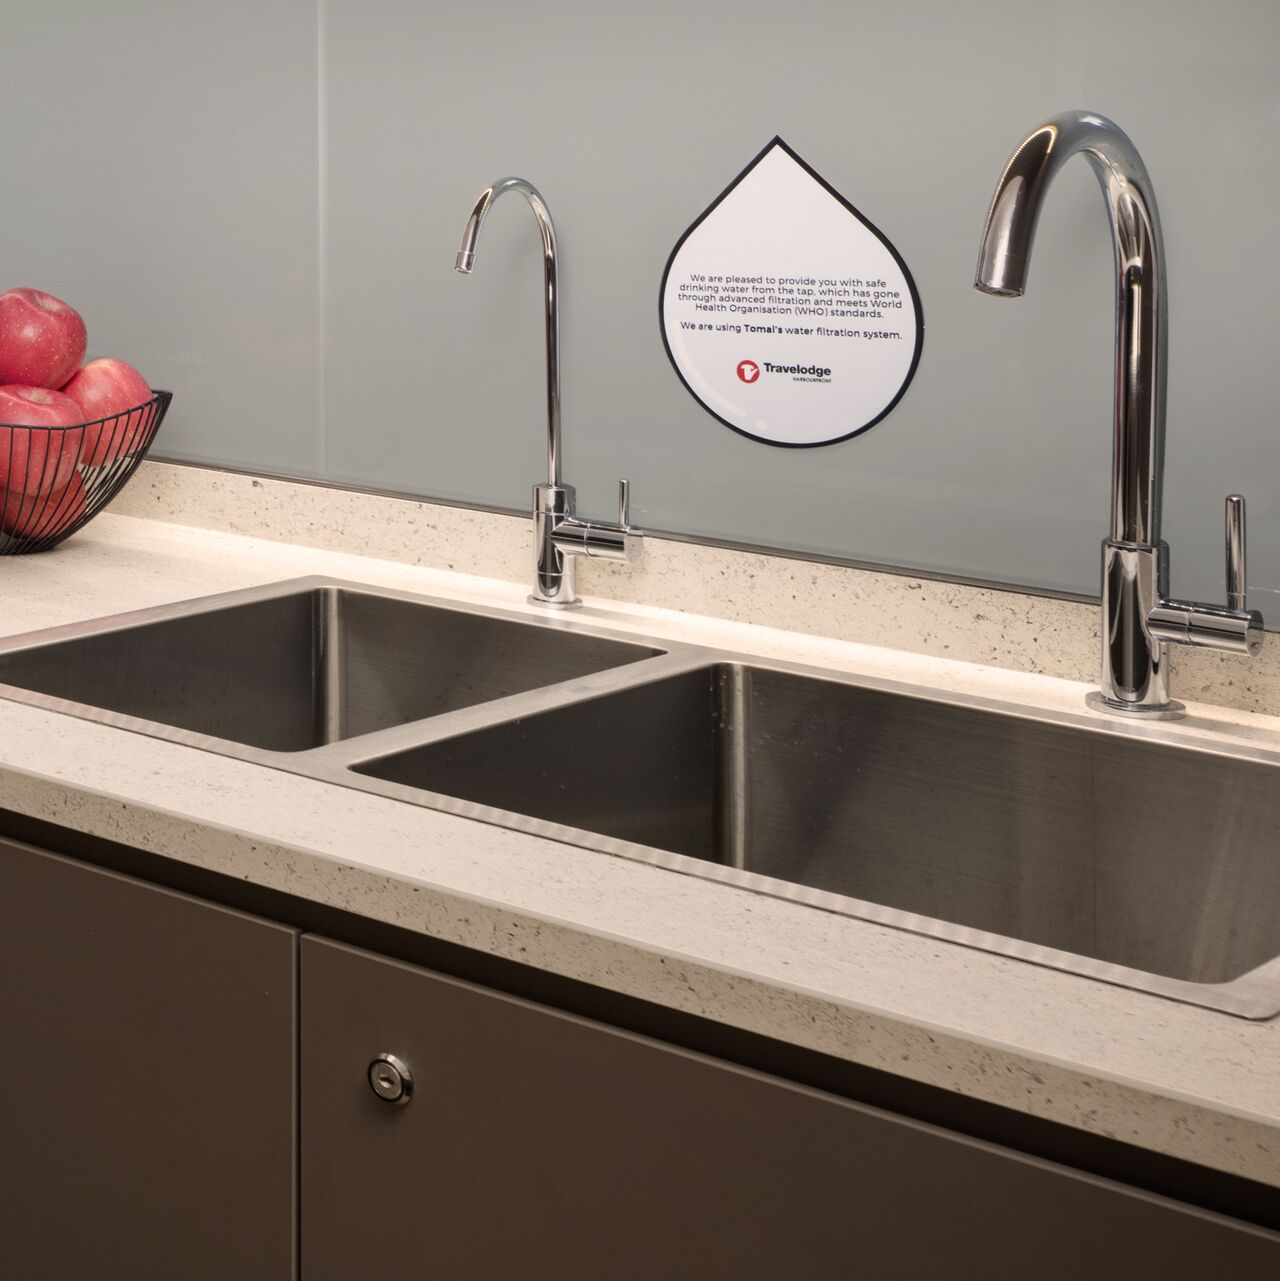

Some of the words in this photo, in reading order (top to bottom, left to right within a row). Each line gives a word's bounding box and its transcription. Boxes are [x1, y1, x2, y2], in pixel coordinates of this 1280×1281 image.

[690, 274, 706, 283] We
[708, 275, 723, 283] are
[725, 275, 763, 285] pleased
[765, 277, 776, 285] to
[778, 277, 816, 287] provide
[818, 280, 837, 288] you
[840, 279, 863, 288] with
[865, 279, 887, 289] safe
[679, 283, 719, 294] drinking
[721, 286, 749, 294] water
[751, 285, 775, 294] from
[777, 287, 794, 295] the
[818, 288, 850, 297] which
[852, 289, 871, 298] has
[873, 291, 900, 300] gone
[678, 293, 716, 303] through
[718, 294, 765, 304] advanced
[768, 296, 811, 306] filtration
[813, 298, 833, 307] and
[835, 299, 868, 308] meets
[870, 300, 902, 310] World
[695, 303, 727, 312] Health
[729, 304, 792, 315] Organisation
[794, 307, 828, 317] (WHO)
[830, 309, 885, 319] standards.
[680, 322, 696, 330] We
[715, 323, 742, 334] using
[743, 324, 783, 334] Tomal's
[784, 326, 814, 336] water
[816, 327, 860, 338] filtration
[863, 330, 903, 340] system.
[763, 362, 831, 377] Travelodge
